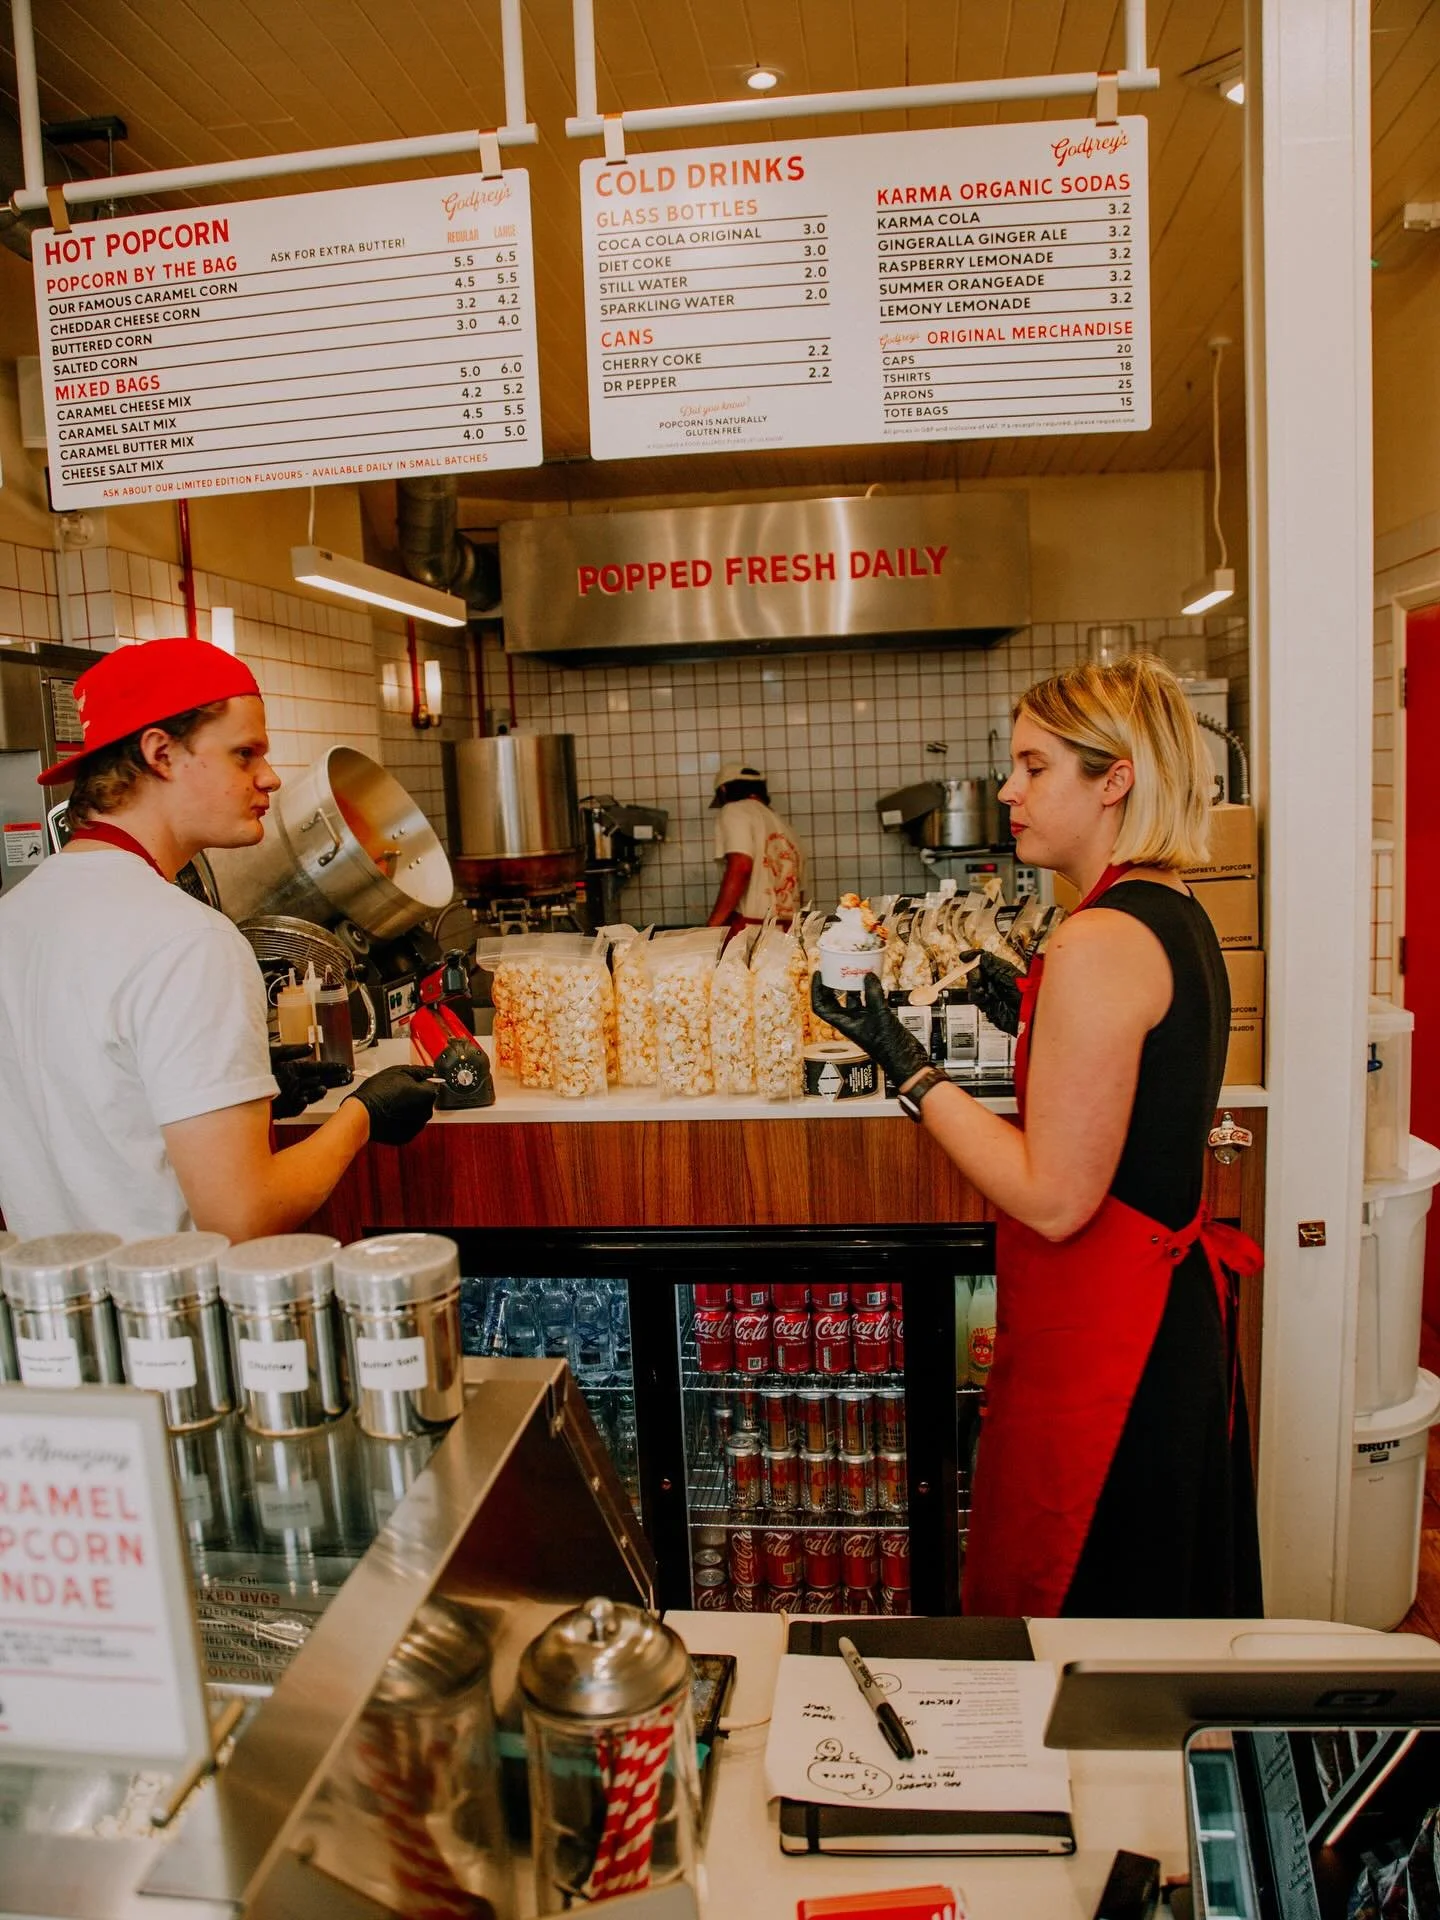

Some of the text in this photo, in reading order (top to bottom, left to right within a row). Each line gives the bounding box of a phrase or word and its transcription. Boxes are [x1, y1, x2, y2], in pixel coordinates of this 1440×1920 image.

[1051, 130, 1128, 167] Godfrey's
[596, 156, 804, 196] COLD DRINKS
[878, 174, 1130, 205] KARMA ORGANIC SODAS
[442, 184, 512, 220] Godfrey's
[597, 200, 758, 228] GLASS BOTTLES
[878, 203, 1130, 229] KARMA COLA 3.2
[45, 219, 229, 265] HOT POPCORN
[270, 238, 405, 262] ASK FOR EXTRA BUTTER!
[599, 222, 825, 251] COCA COLA ORIGINAL 3.0
[878, 226, 1130, 251] GINGERALLA GINGER ALE 3.2
[599, 244, 825, 272] DIET COKE 3.0
[879, 248, 1131, 273] RASPBERRY LEMONADE 3.2
[47, 256, 237, 294] POPCORN BY THE BAG
[49, 251, 516, 315] OUR FAMOUS CARAMEL CORN 5.5 6.5
[600, 266, 826, 294] STILL WATER 2.0
[880, 271, 1131, 295] SUMMER ORANGEADE 3.2
[51, 272, 516, 335] CHEDDAR CHEESE CORN 4.5 5.5
[601, 288, 827, 316] SPARKLING WATER 2.0
[880, 293, 1131, 317] LEMONY LEMONADE 3.2
[52, 293, 518, 355] BUTTERED CORN 3.2 4.2
[928, 328, 1005, 344] ORIGINAL
[1012, 322, 1132, 339] MERCHANDISE
[54, 314, 519, 376] SALTED CORN 3.0 4.0
[602, 329, 653, 348] CANS
[603, 345, 829, 371] CHERRY COKE 2.2
[883, 344, 1131, 366] CAPS 20
[604, 367, 829, 392] DR PEPPER 2.2
[884, 362, 1131, 383] TSHIRTS 18
[56, 375, 160, 400] MIXED BAGS
[57, 362, 521, 420] CARAMEL CHEESE MIX 5.0 6.0
[884, 380, 1132, 400] APRONS 25
[59, 383, 522, 440] CARAMEL SALT MIX 4.2 5.2
[660, 420, 702, 428] POPCORN
[716, 416, 767, 425] NATURALLY
[884, 398, 1132, 418] TOTE BAGS 15
[61, 404, 524, 460] CARAMEL BUTTER MIX 4.5 5.5
[686, 428, 719, 436] GLUTEN
[62, 425, 525, 480] CHEESE SALT MIX 4.0 5.0
[104, 489, 119, 497] ASK
[123, 485, 152, 495] ABOUT
[156, 484, 173, 492] OUR
[177, 480, 212, 490] LIMITED
[216, 476, 251, 486] EDITION
[255, 471, 303, 483] FLAVOURS
[312, 465, 362, 476] AVAILABLE
[366, 463, 392, 471] DAILY
[397, 461, 406, 469] IN
[410, 459, 441, 468] SMALL
[445, 454, 488, 464] BATCHES
[578, 546, 948, 596] POPPED FRESH DAILY
[1358, 1440, 1400, 1453] BRUTE
